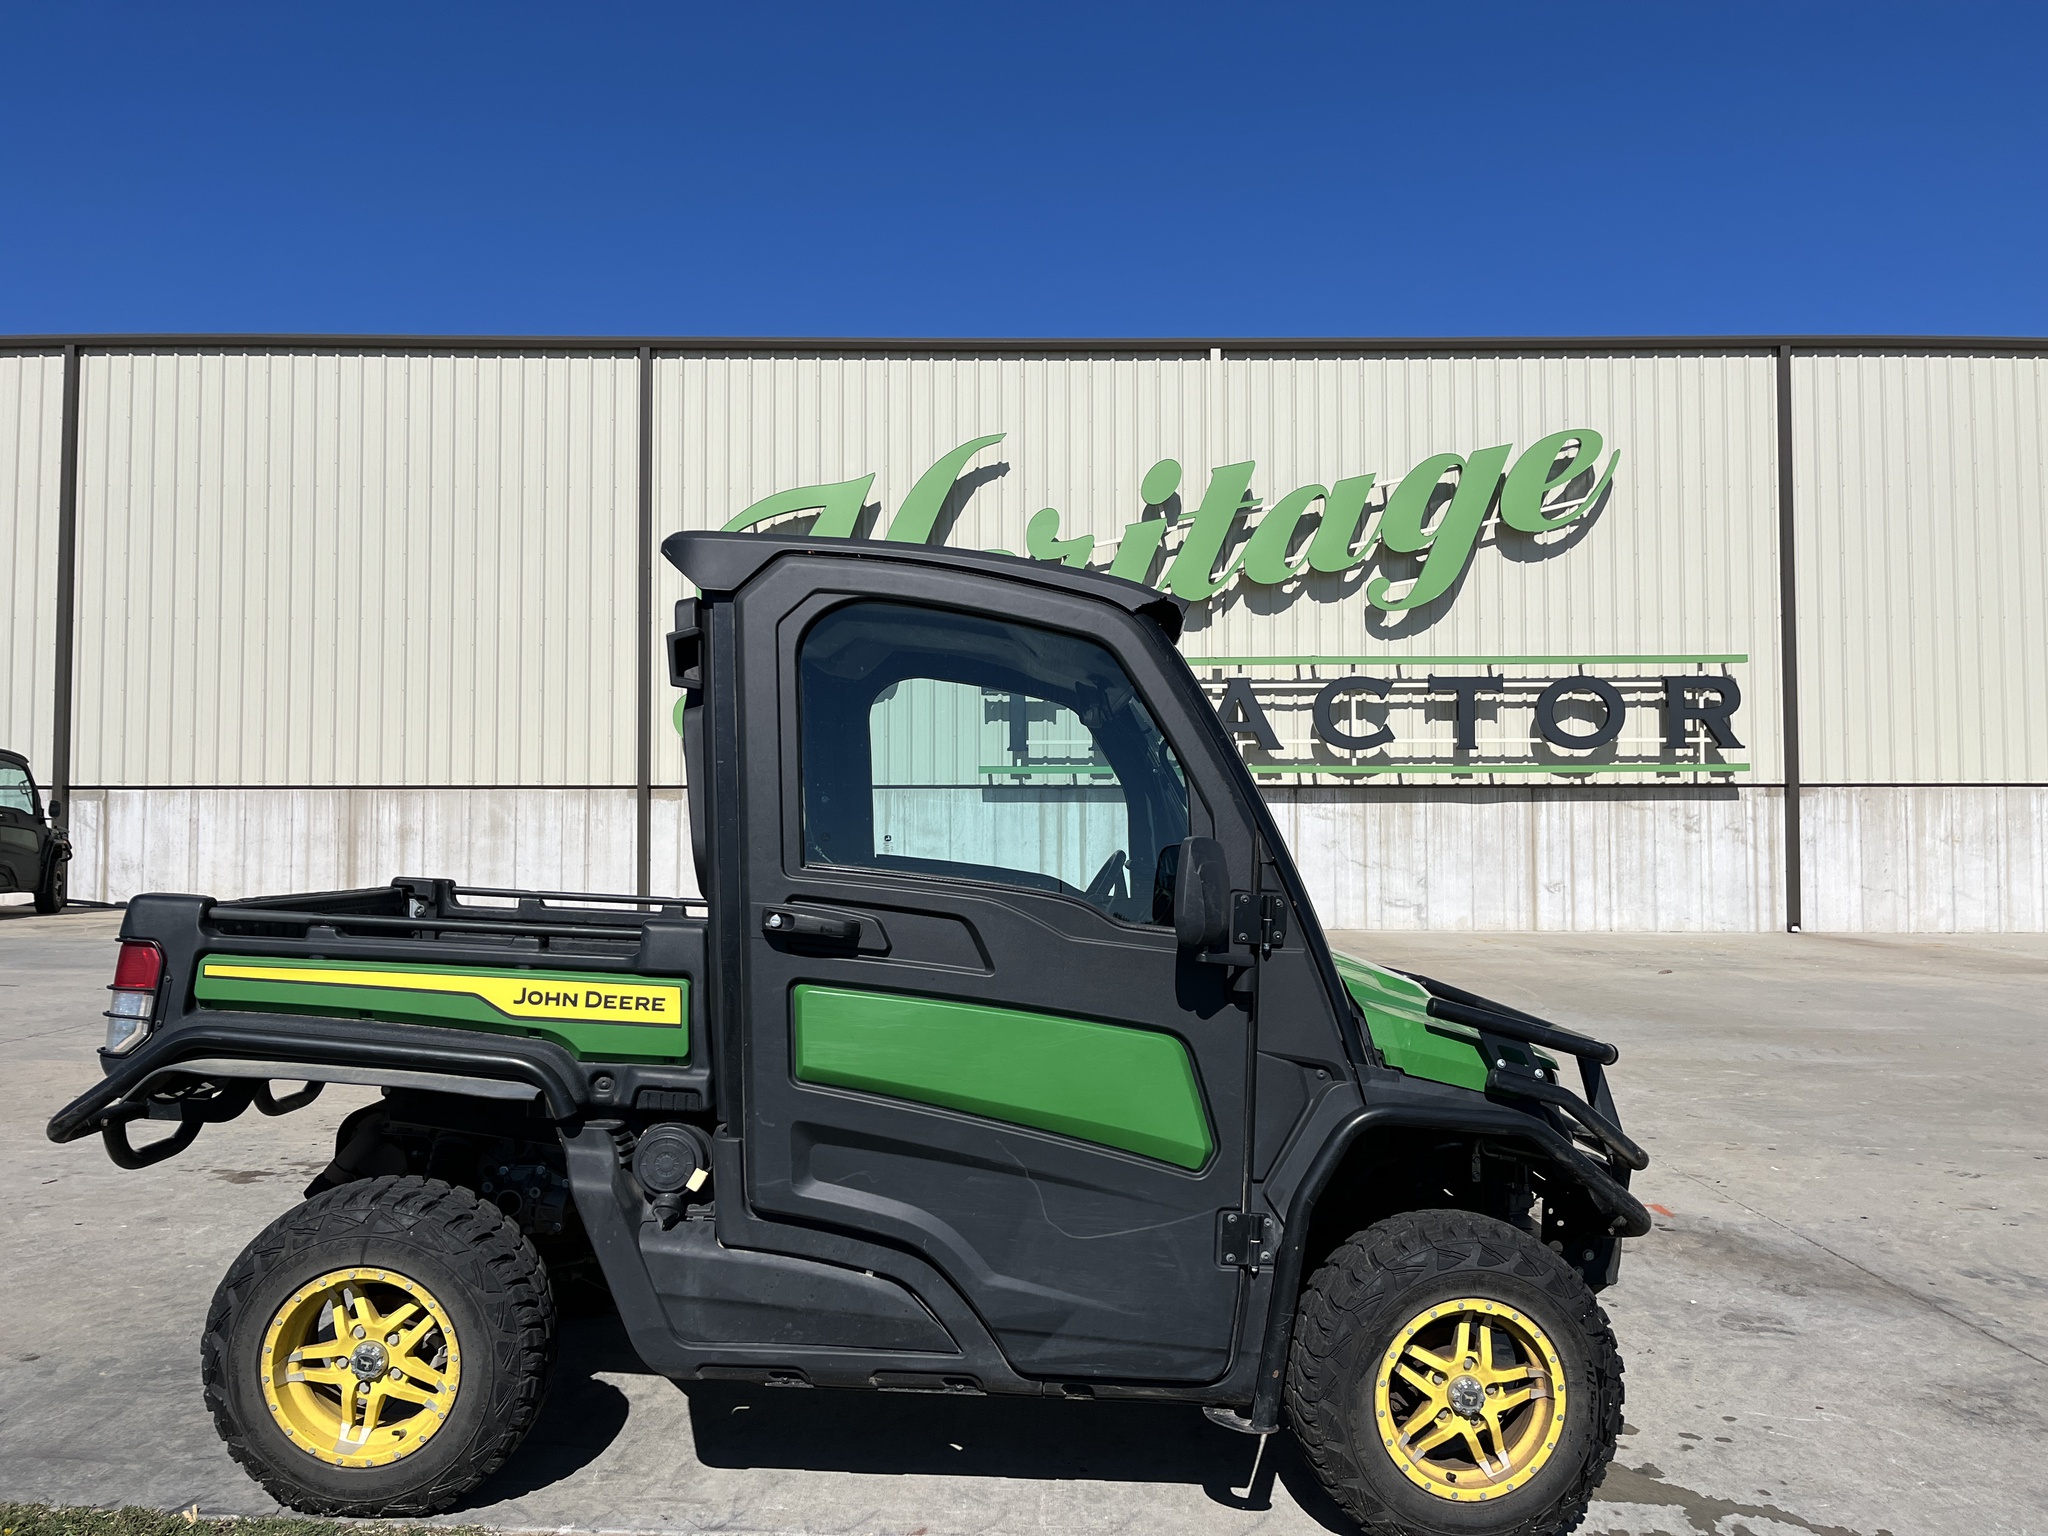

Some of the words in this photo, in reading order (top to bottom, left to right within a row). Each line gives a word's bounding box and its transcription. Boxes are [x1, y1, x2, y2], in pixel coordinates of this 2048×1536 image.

[720, 428, 1620, 611] ritage
[981, 674, 1746, 751] TACTOR
[513, 987, 579, 1008] JOHN
[584, 990, 666, 1012] DEERE
